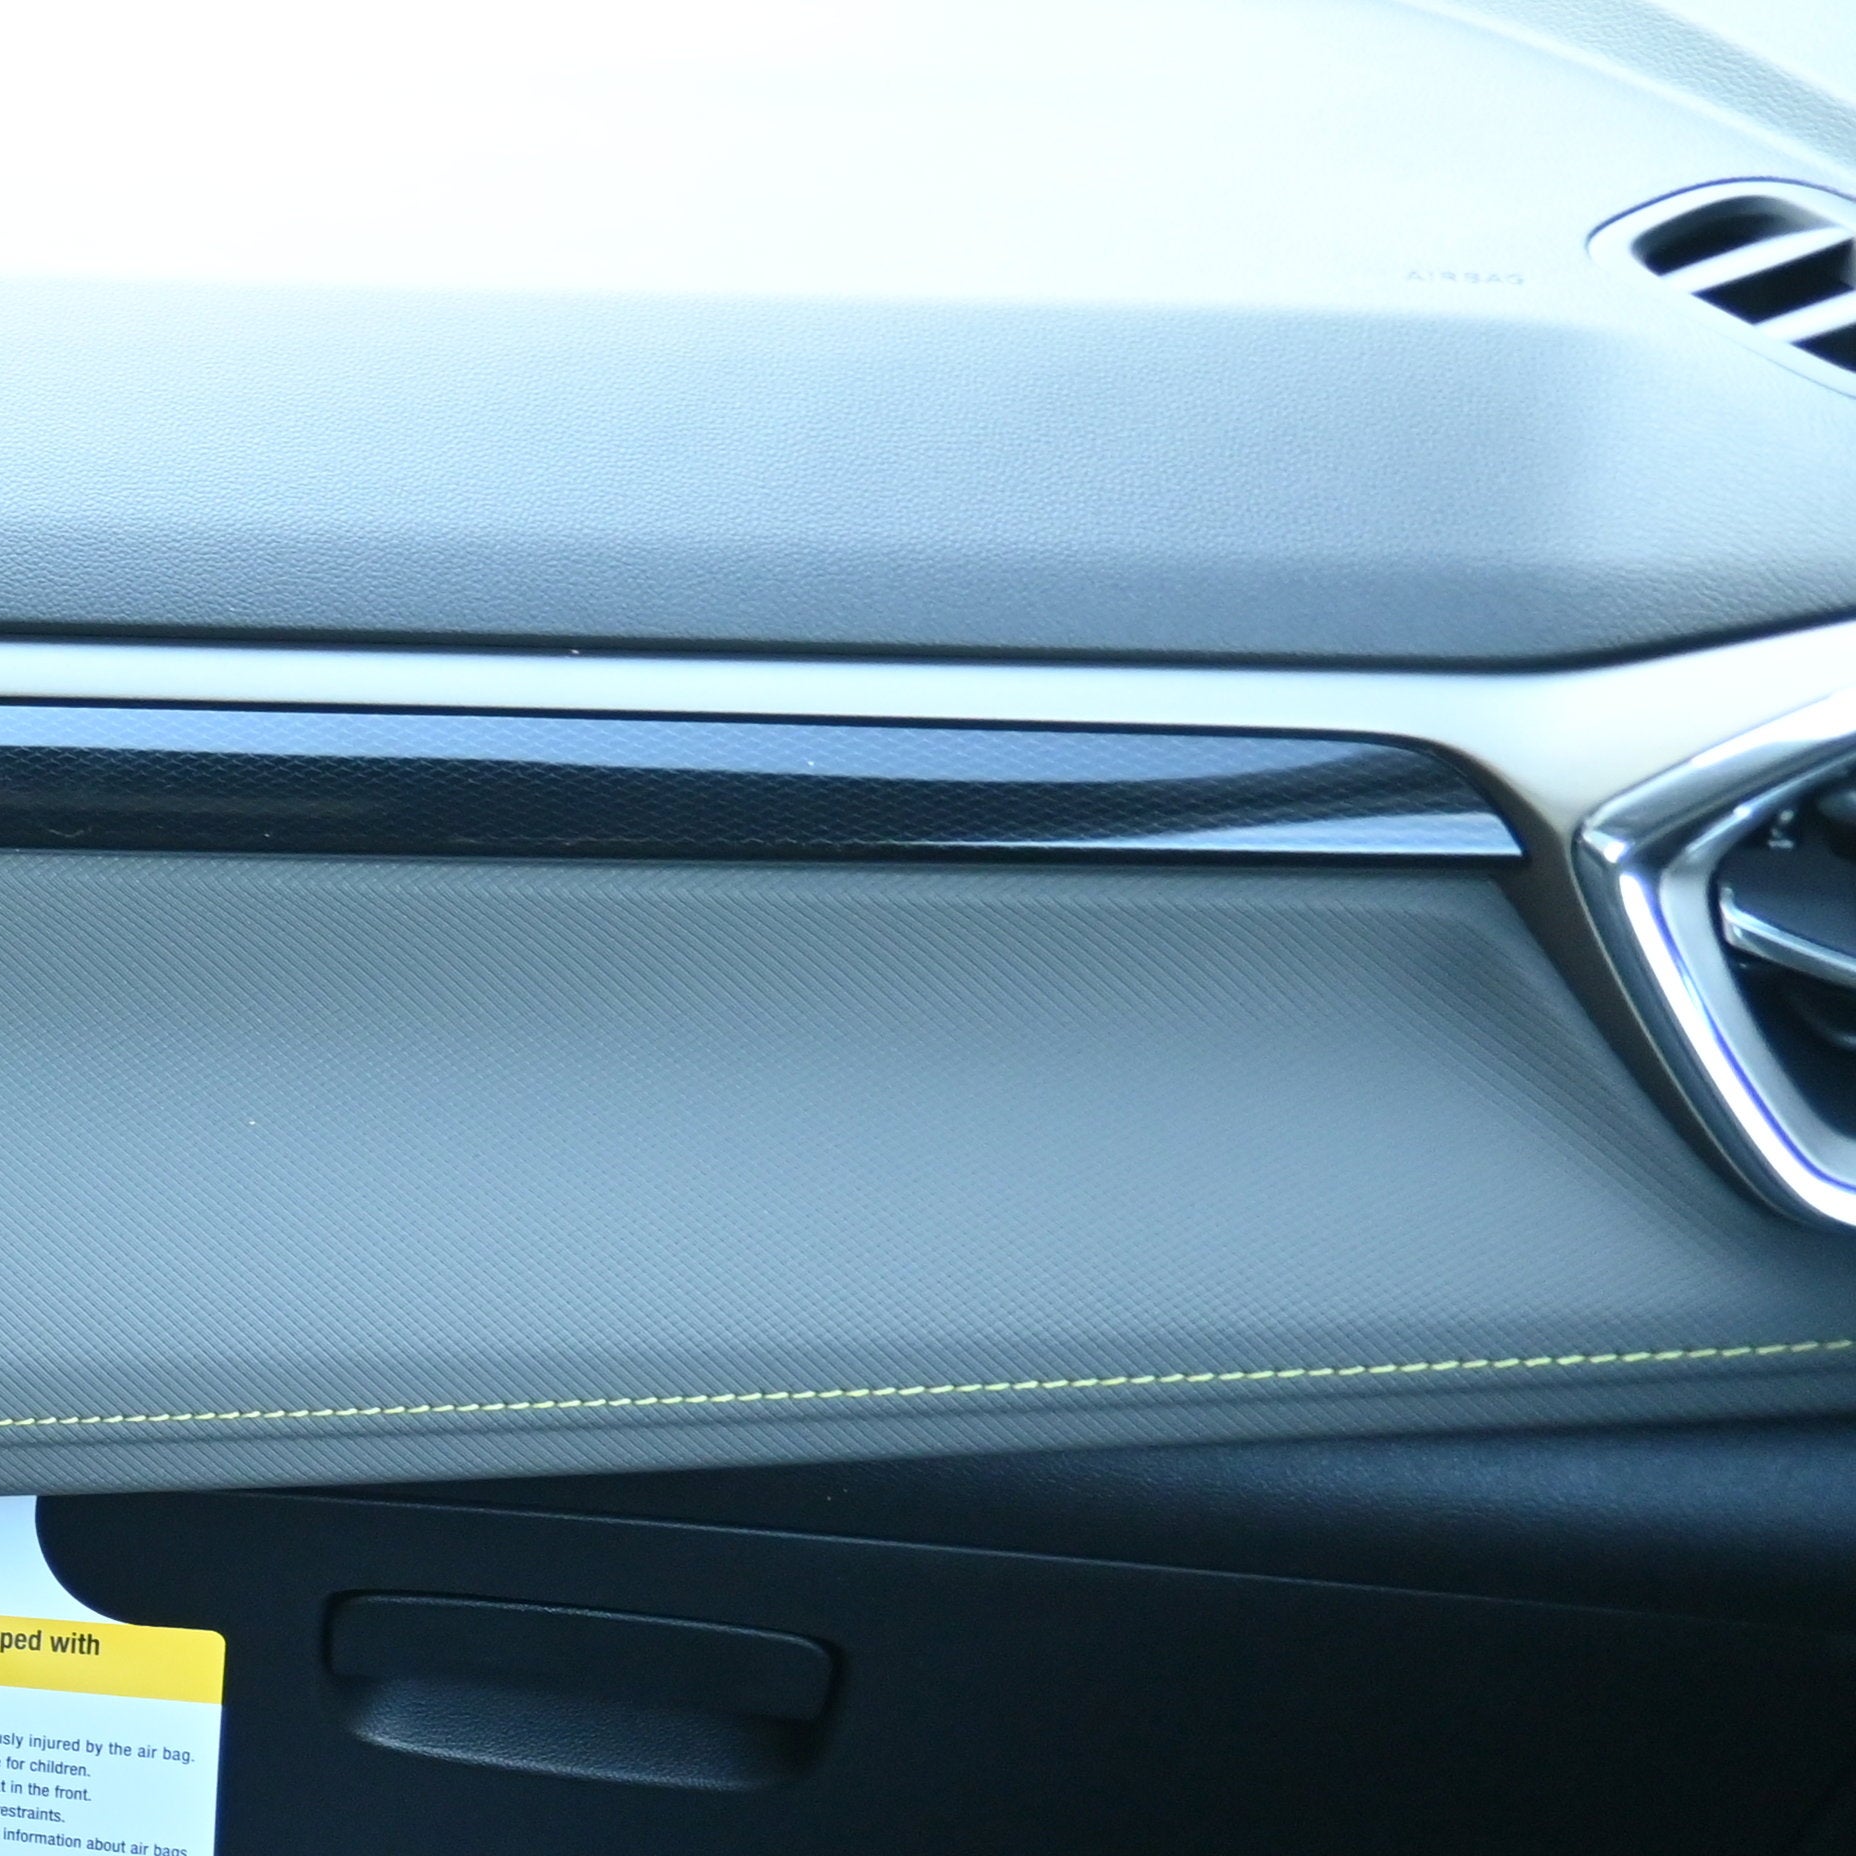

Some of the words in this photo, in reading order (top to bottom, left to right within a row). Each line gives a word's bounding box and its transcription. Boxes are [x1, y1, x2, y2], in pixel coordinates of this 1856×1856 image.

[50, 1632, 100, 1656] with
[29, 1734, 80, 1751] injured
[86, 1740, 103, 1756] by
[108, 1742, 132, 1756] the
[137, 1745, 157, 1759] air
[163, 1747, 195, 1765] bag.
[6, 1756, 25, 1770] for
[30, 1758, 91, 1777] children.
[11, 1781, 23, 1794] in
[28, 1783, 50, 1797] the
[55, 1785, 92, 1801] front.
[3, 1827, 81, 1849] information
[87, 1836, 126, 1853] about
[130, 1842, 149, 1856] air
